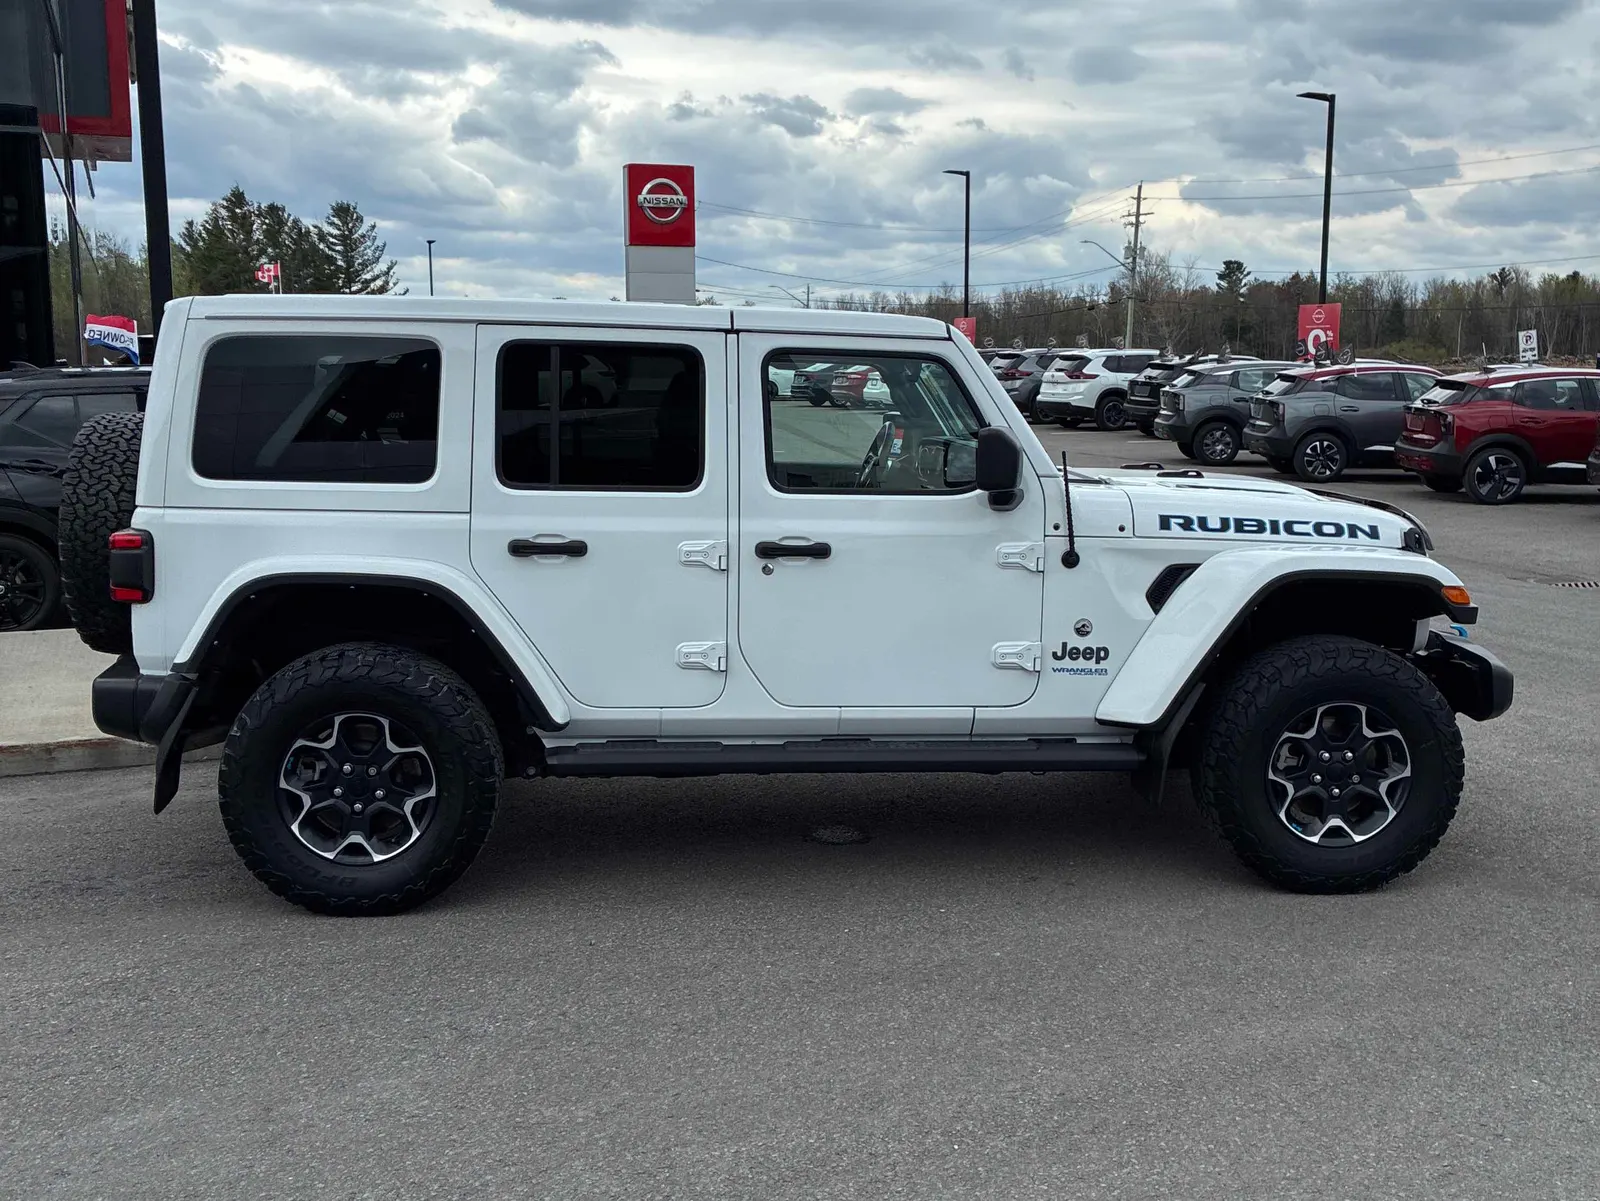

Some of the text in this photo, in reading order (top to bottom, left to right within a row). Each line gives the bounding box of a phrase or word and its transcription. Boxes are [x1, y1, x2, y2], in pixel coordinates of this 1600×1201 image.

[643, 197, 683, 205] NISSAN
[1158, 514, 1380, 540] RUBICON
[1052, 642, 1110, 664] Jeep
